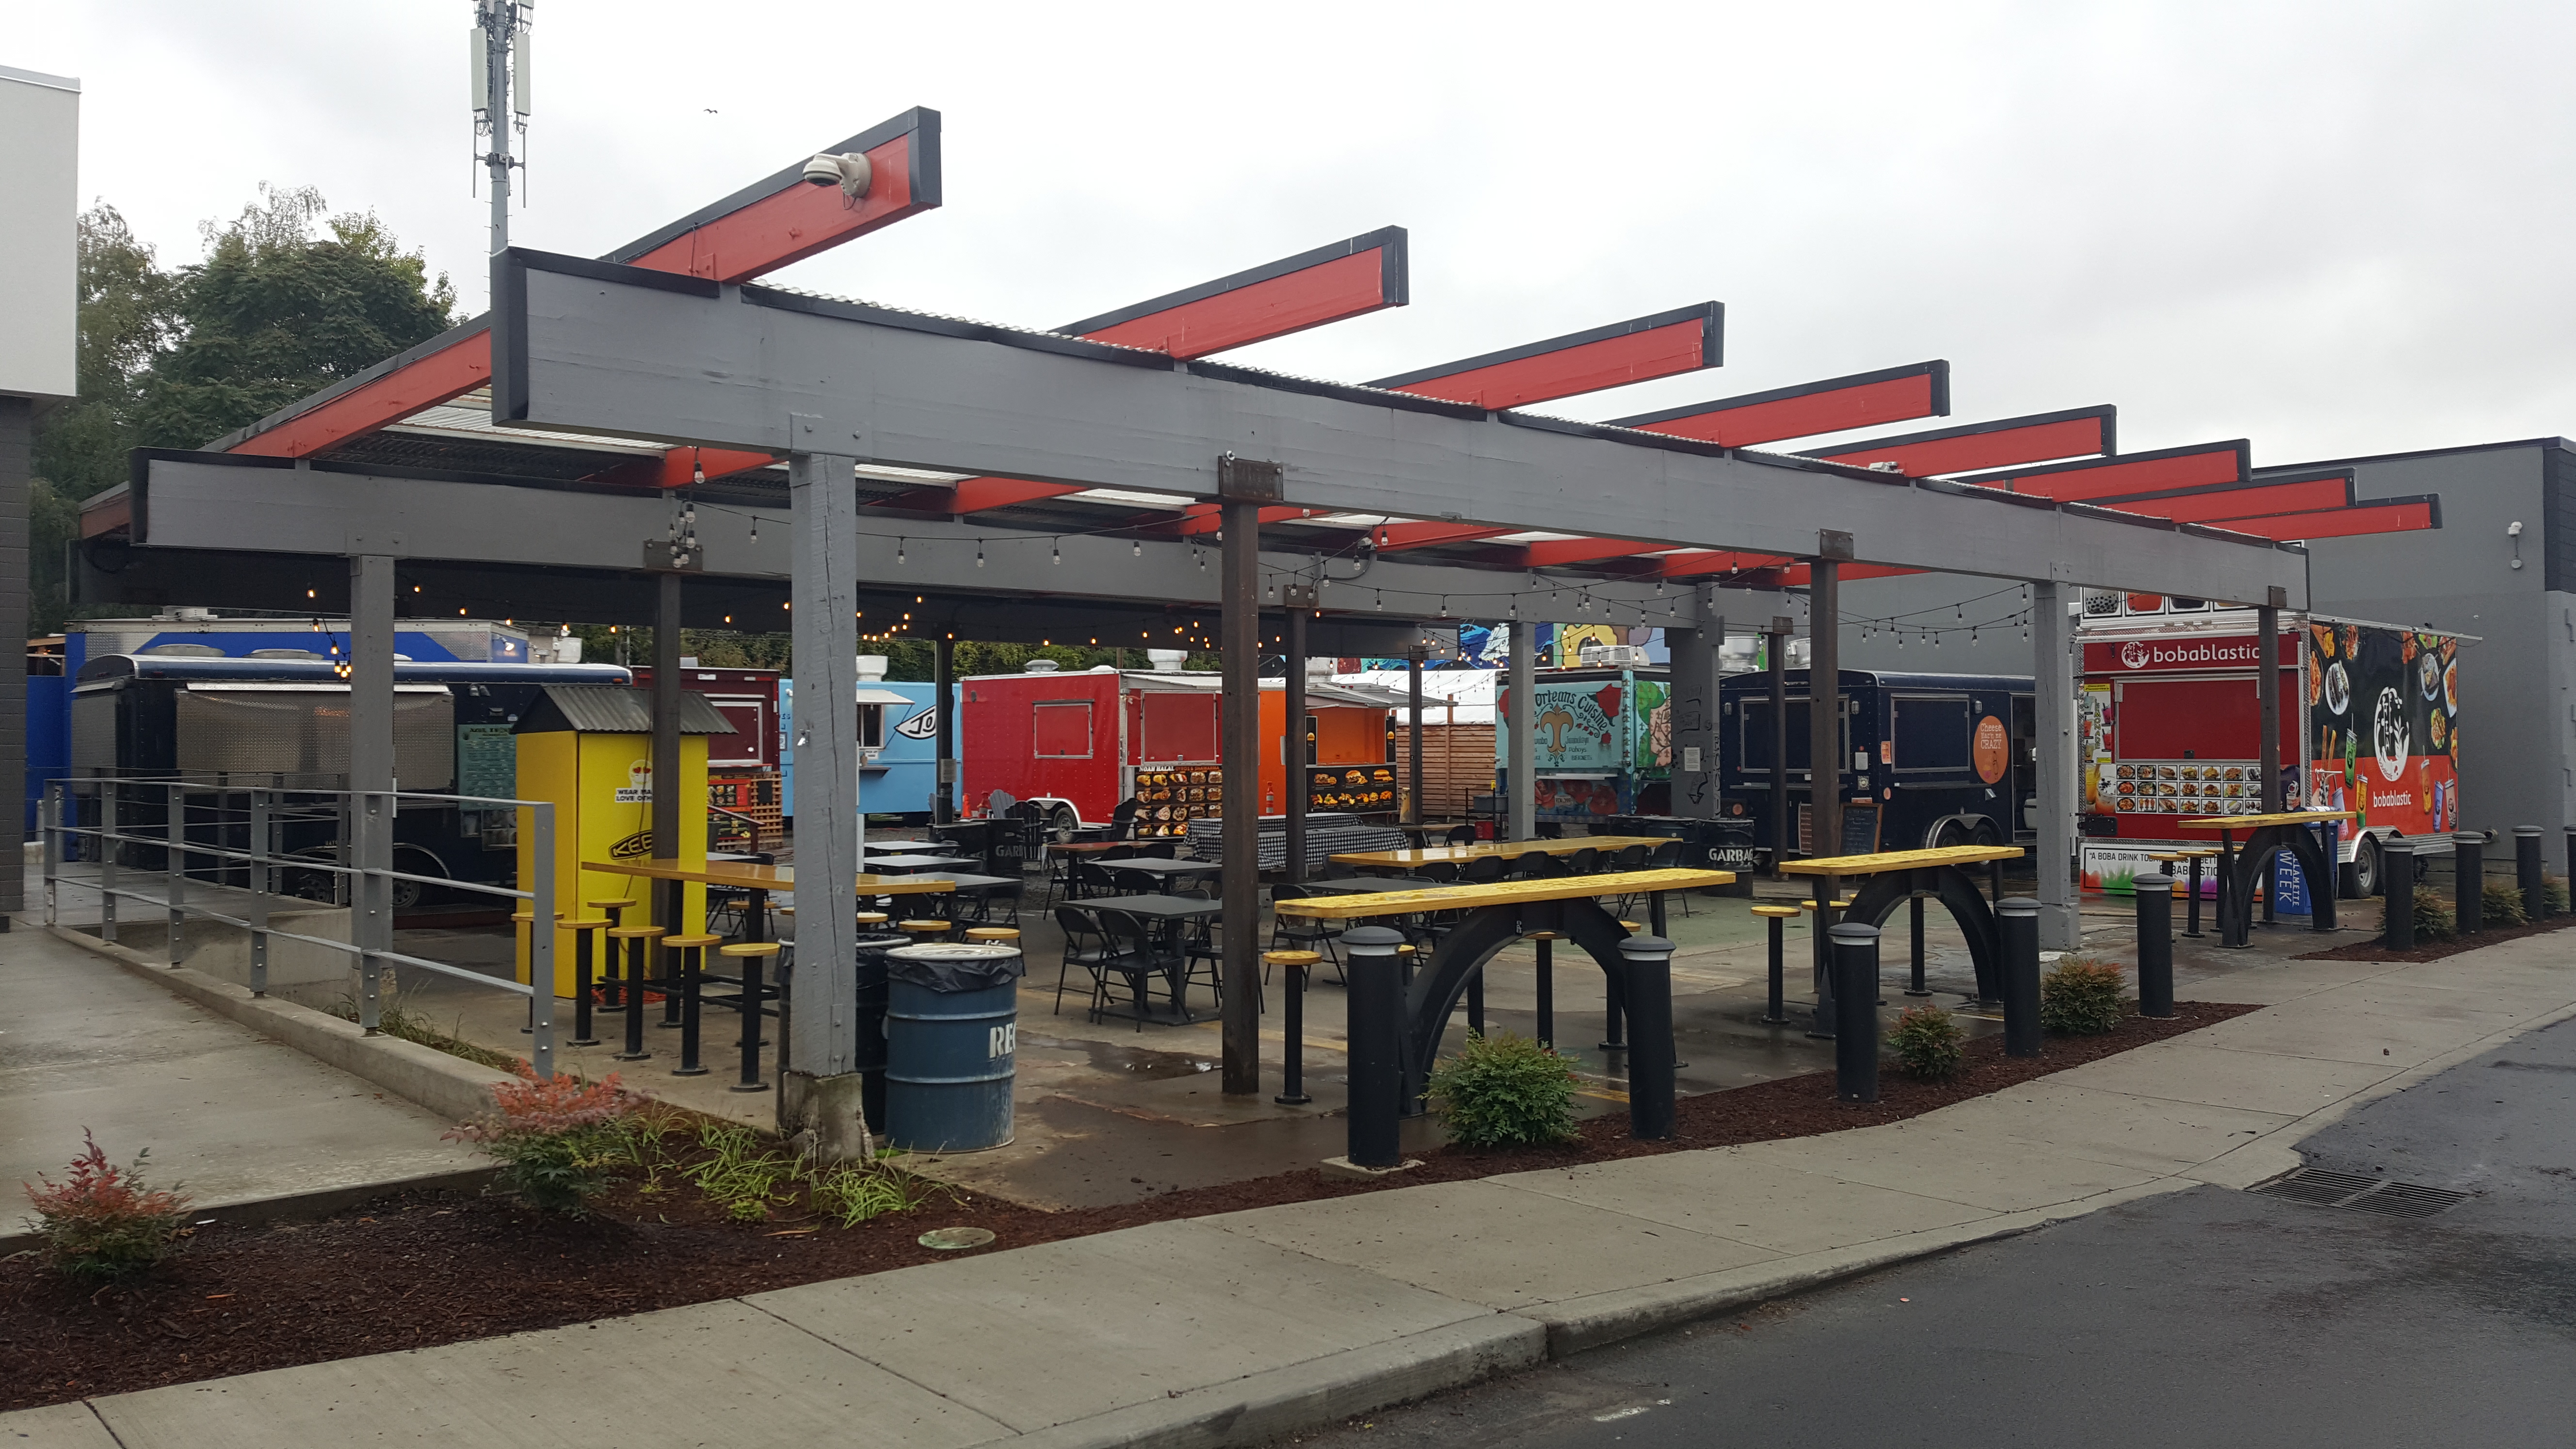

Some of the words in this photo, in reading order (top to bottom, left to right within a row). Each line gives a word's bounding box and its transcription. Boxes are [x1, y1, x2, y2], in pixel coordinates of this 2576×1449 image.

[2154, 644, 2259, 662] bobablastic
[1578, 696, 1608, 730] Cuisine
[1980, 723, 2002, 731] Cheese
[1980, 740, 2002, 749] CRAZY
[2373, 790, 2411, 807] bobablastic
[2118, 853, 2139, 861] DRINK
[2279, 851, 2292, 902] WEEK
